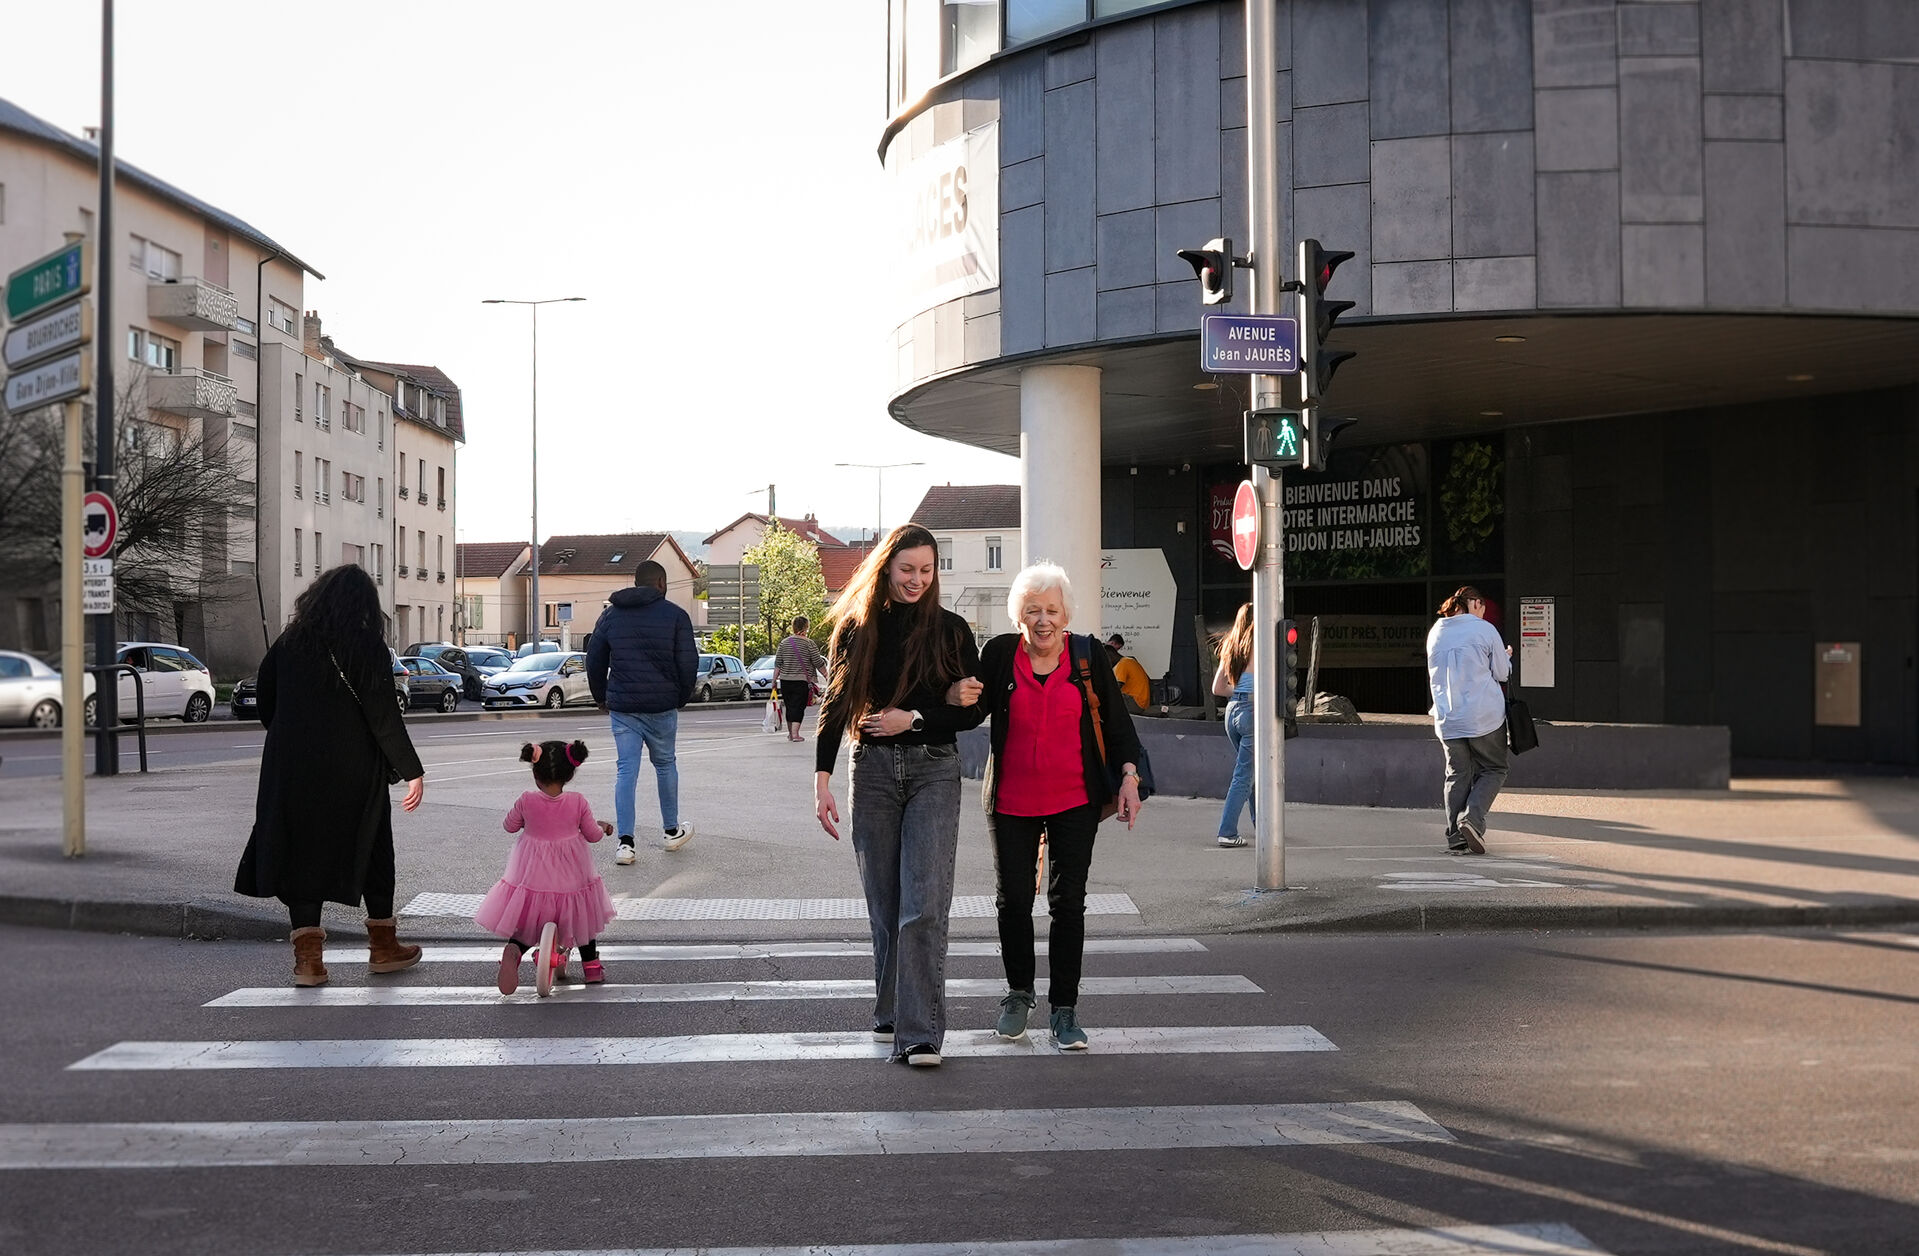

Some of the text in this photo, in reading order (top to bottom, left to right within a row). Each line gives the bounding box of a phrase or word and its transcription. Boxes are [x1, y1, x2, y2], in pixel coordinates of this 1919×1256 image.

[32, 265, 62, 298] PARIS
[26, 312, 80, 350] BOURROCHES
[1228, 326, 1276, 341] AVENUE
[1212, 345, 1292, 362] Jean JAURÈS
[1212, 494, 1234, 507] Produc
[1285, 476, 1401, 506] BIENVENUE DANS
[1212, 508, 1234, 531] D'I
[1283, 497, 1416, 529] OTRE INTERMARCHÉ
[1288, 531, 1328, 553] DIJON
[1330, 523, 1421, 551] JEAN-JAURÈS
[1323, 626, 1349, 640] TOUT
[1382, 626, 1409, 640] TOUT
